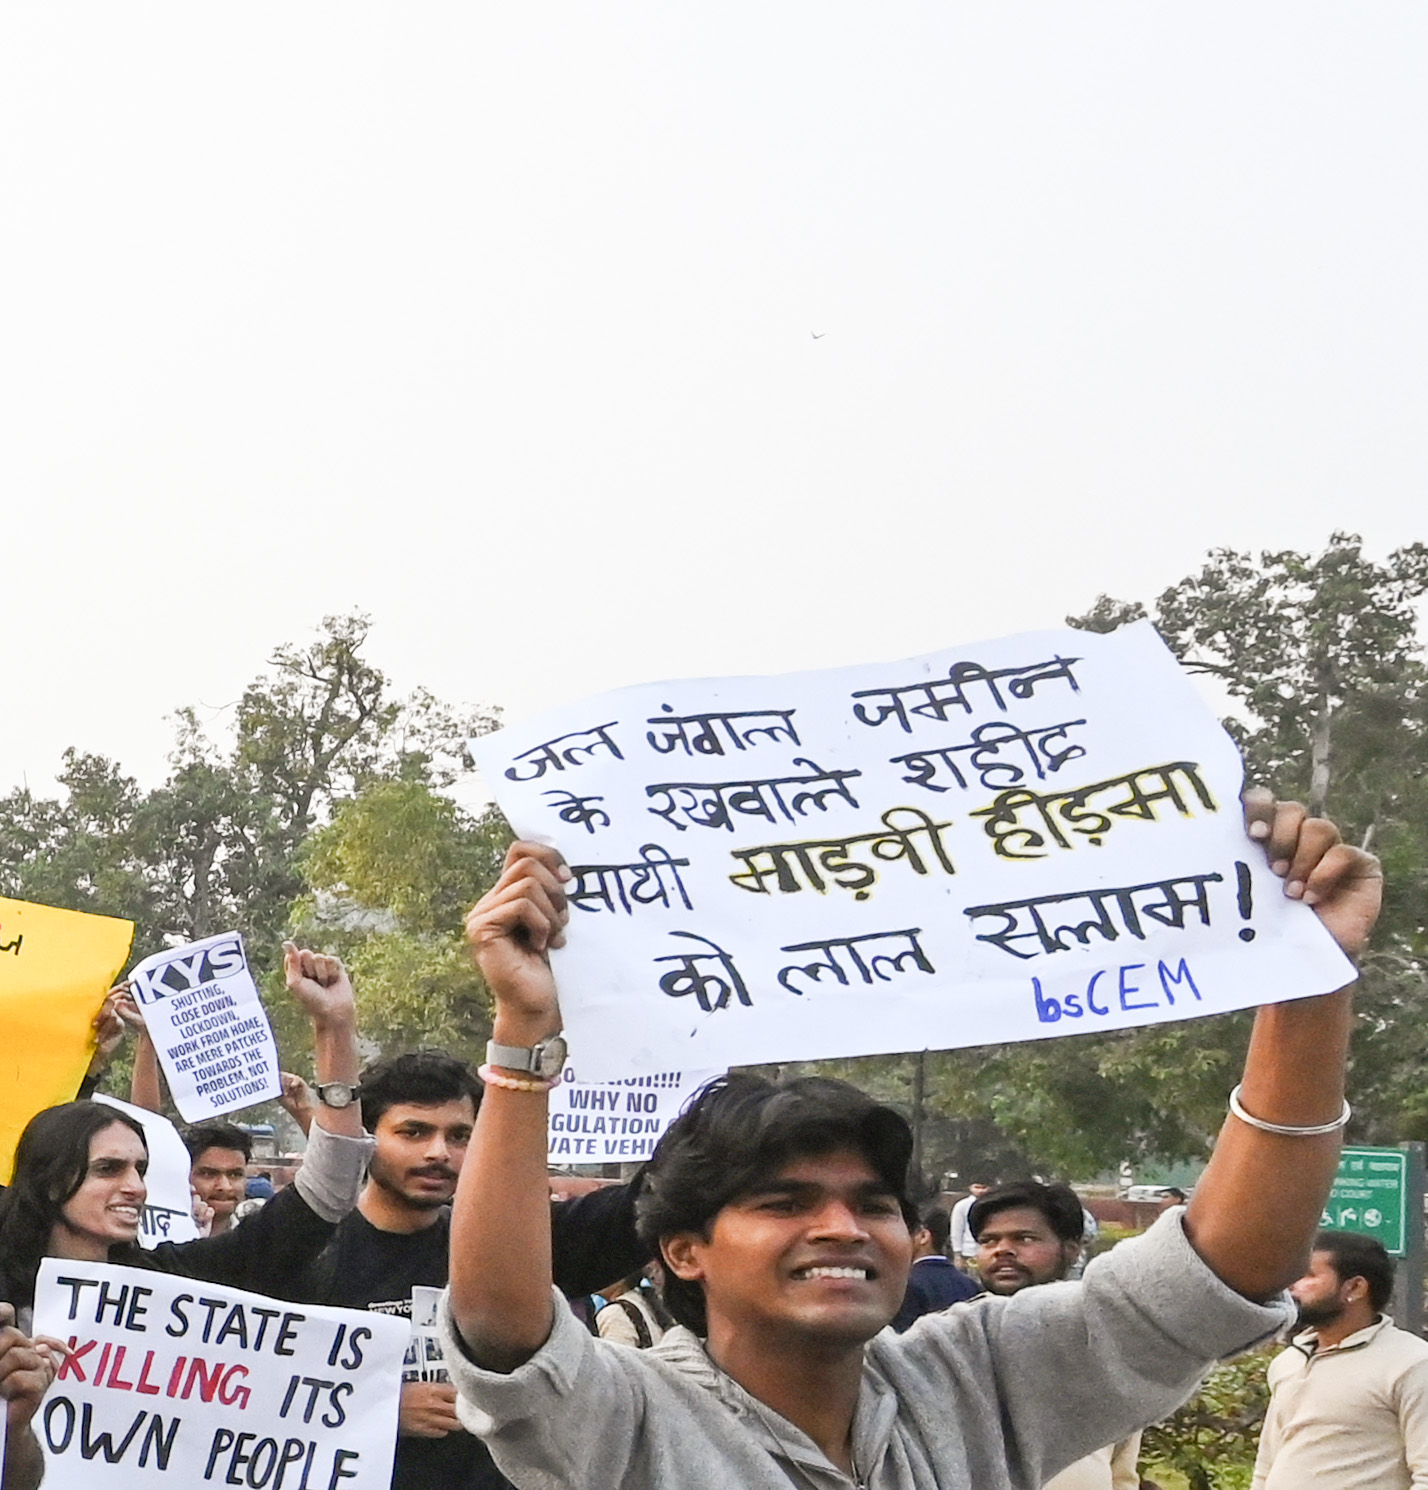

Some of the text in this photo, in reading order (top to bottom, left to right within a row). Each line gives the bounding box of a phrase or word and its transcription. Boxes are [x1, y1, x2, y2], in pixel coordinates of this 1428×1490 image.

[504, 654, 1085, 781] जल जंगल जमीन
[540, 718, 1087, 834] के रखवाले शहीद
[565, 761, 1218, 916] साथी माड़वी हीड़मा
[136, 940, 245, 1004] KYS
[652, 930, 754, 1012] को
[777, 926, 936, 997] लाल
[1031, 957, 1202, 1023] bsCEM
[171, 984, 225, 1011] SHUTTING,
[171, 995, 237, 1027] CLOSE DOWN,
[180, 1010, 240, 1039] LOCKDOWN,
[167, 1016, 264, 1060] WORK FROM HOME,
[175, 1030, 268, 1073] ARE MERE PATCHES
[193, 1048, 263, 1082] TOWARDS THE
[196, 1061, 270, 1097] PROBLEM, NOT
[210, 1078, 269, 1107] SOLUTIONS!
[569, 1089, 658, 1113] WHY NO
[57, 1276, 372, 1370] THE STATE IS
[58, 1335, 354, 1428] KILLING ITS
[43, 1396, 181, 1470] OWN
